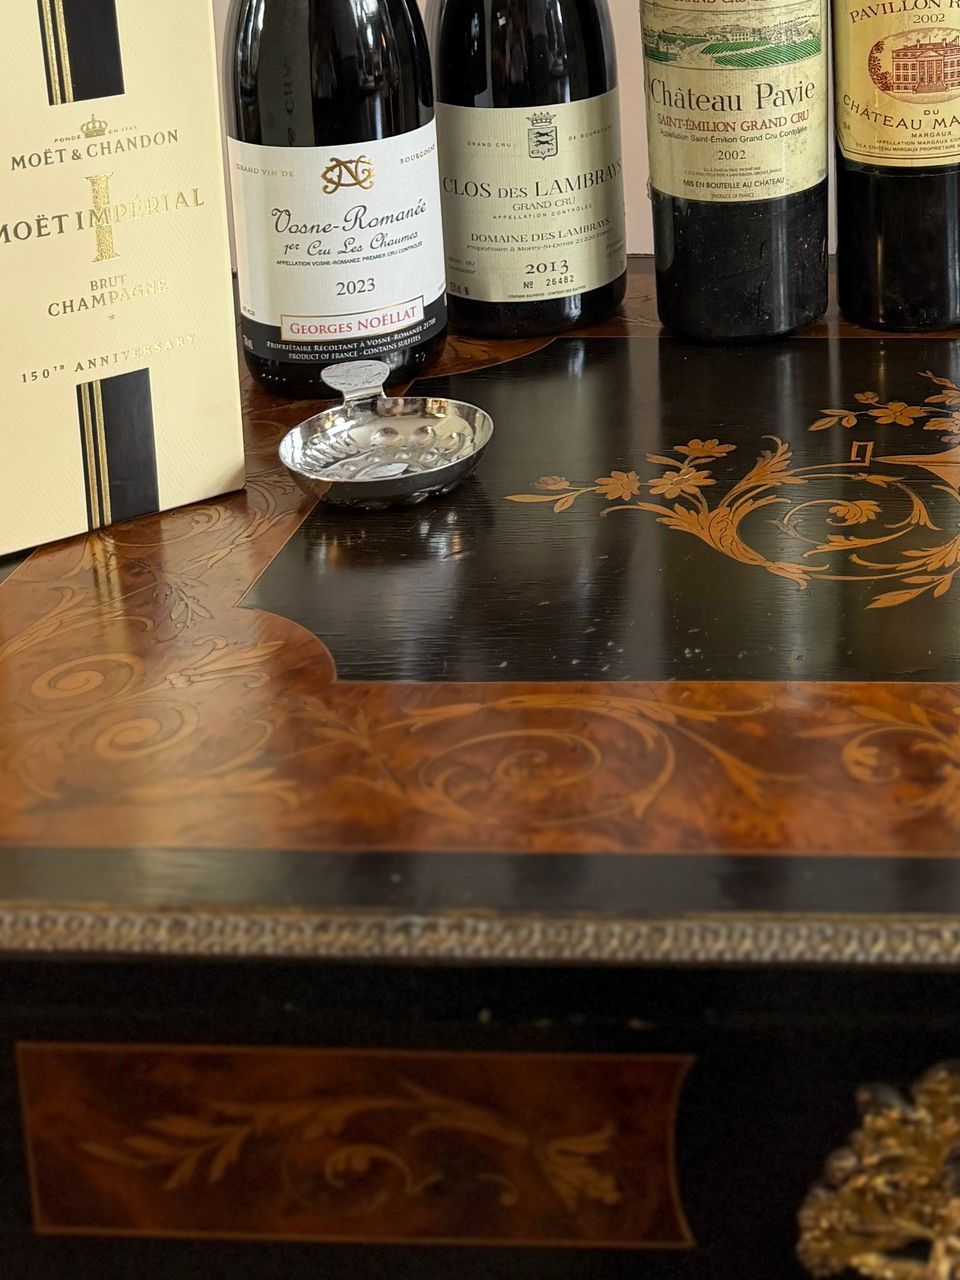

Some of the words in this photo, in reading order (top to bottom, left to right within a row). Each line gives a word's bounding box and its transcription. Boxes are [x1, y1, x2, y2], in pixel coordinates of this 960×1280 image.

[913, 13, 945, 24] 2002
[651, 78, 743, 112] Château
[755, 80, 815, 110] Pavie
[658, 113, 736, 133] SAINT-ÉMILION
[740, 116, 787, 132] GRAND
[790, 109, 810, 124] CRU
[843, 94, 922, 130] CHÂTEAU
[660, 129, 689, 141] Appellation
[690, 134, 738, 143] Saint-Émilion
[740, 134, 763, 143] Grand
[764, 131, 778, 140] Cru
[911, 130, 952, 138] MARGAUX
[917, 138, 948, 146] MARGAUX
[11, 148, 68, 170] MOËT
[71, 148, 83, 161] &
[86, 129, 180, 158] CHANDON
[467, 140, 492, 148] GRAND
[718, 149, 746, 161] 2002
[236, 163, 260, 175] GRAND
[261, 168, 278, 177] VIN
[282, 170, 294, 178] DE
[443, 176, 492, 199] CLOS
[498, 187, 528, 199] DES
[683, 179, 695, 188] MIS
[696, 180, 705, 188] EN
[706, 180, 740, 189] BOUTEILLE
[742, 179, 752, 187] AU
[75, 187, 205, 232] IMPÉRIAL
[512, 200, 552, 211] GRAND
[554, 196, 576, 208] CRU
[272, 198, 426, 234] Vosne-Romanée
[471, 232, 528, 243] DOMAINE
[531, 231, 556, 243] DES
[558, 218, 610, 239] LAMBRAYS
[307, 239, 332, 257] Cru
[338, 237, 364, 255] Les
[370, 231, 419, 250] Chaumes
[467, 244, 508, 253] Propriétaire
[575, 234, 596, 244] 21220
[276, 259, 311, 267] APPELLATION
[362, 252, 387, 261] PREMIER
[387, 249, 398, 258] CRU
[525, 259, 569, 275] 2013
[89, 274, 128, 291] BRUT
[336, 278, 376, 296] 2023
[545, 275, 575, 287] 26482
[48, 279, 169, 317] CHAMPAGNE
[290, 319, 353, 335] GEORGES
[357, 306, 417, 331] NOËLLAT
[74, 333, 196, 373] ANNIVERSARY
[267, 340, 312, 352] PROPRIÉTAIRE
[314, 341, 359, 352] RÉCOLTANT
[289, 352, 319, 360] PRODUCT
[331, 350, 359, 360] FRANCE
[363, 343, 397, 355] CONTAINS
[398, 334, 421, 348] SULFITES
